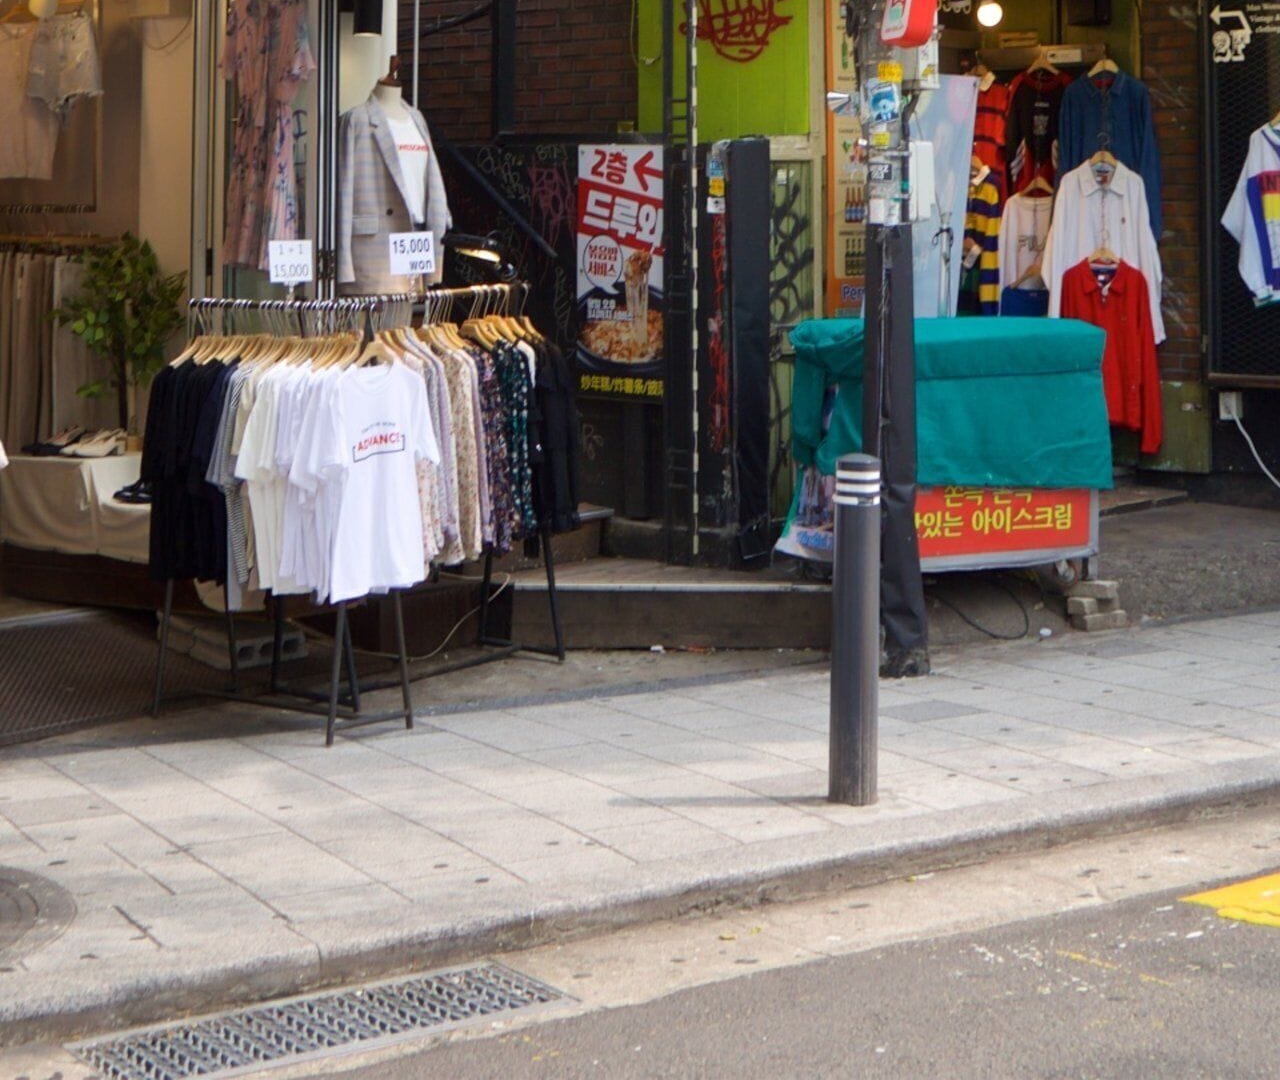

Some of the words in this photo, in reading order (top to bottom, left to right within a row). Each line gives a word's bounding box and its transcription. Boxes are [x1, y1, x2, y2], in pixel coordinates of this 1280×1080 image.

[590, 148, 628, 185] 2층
[392, 238, 431, 255] 15,000
[587, 243, 618, 262] 볶음밥
[273, 263, 310, 279] 15,000
[409, 260, 433, 271] won
[587, 262, 618, 278] 서비스
[970, 503, 1073, 535] 아이스크림
